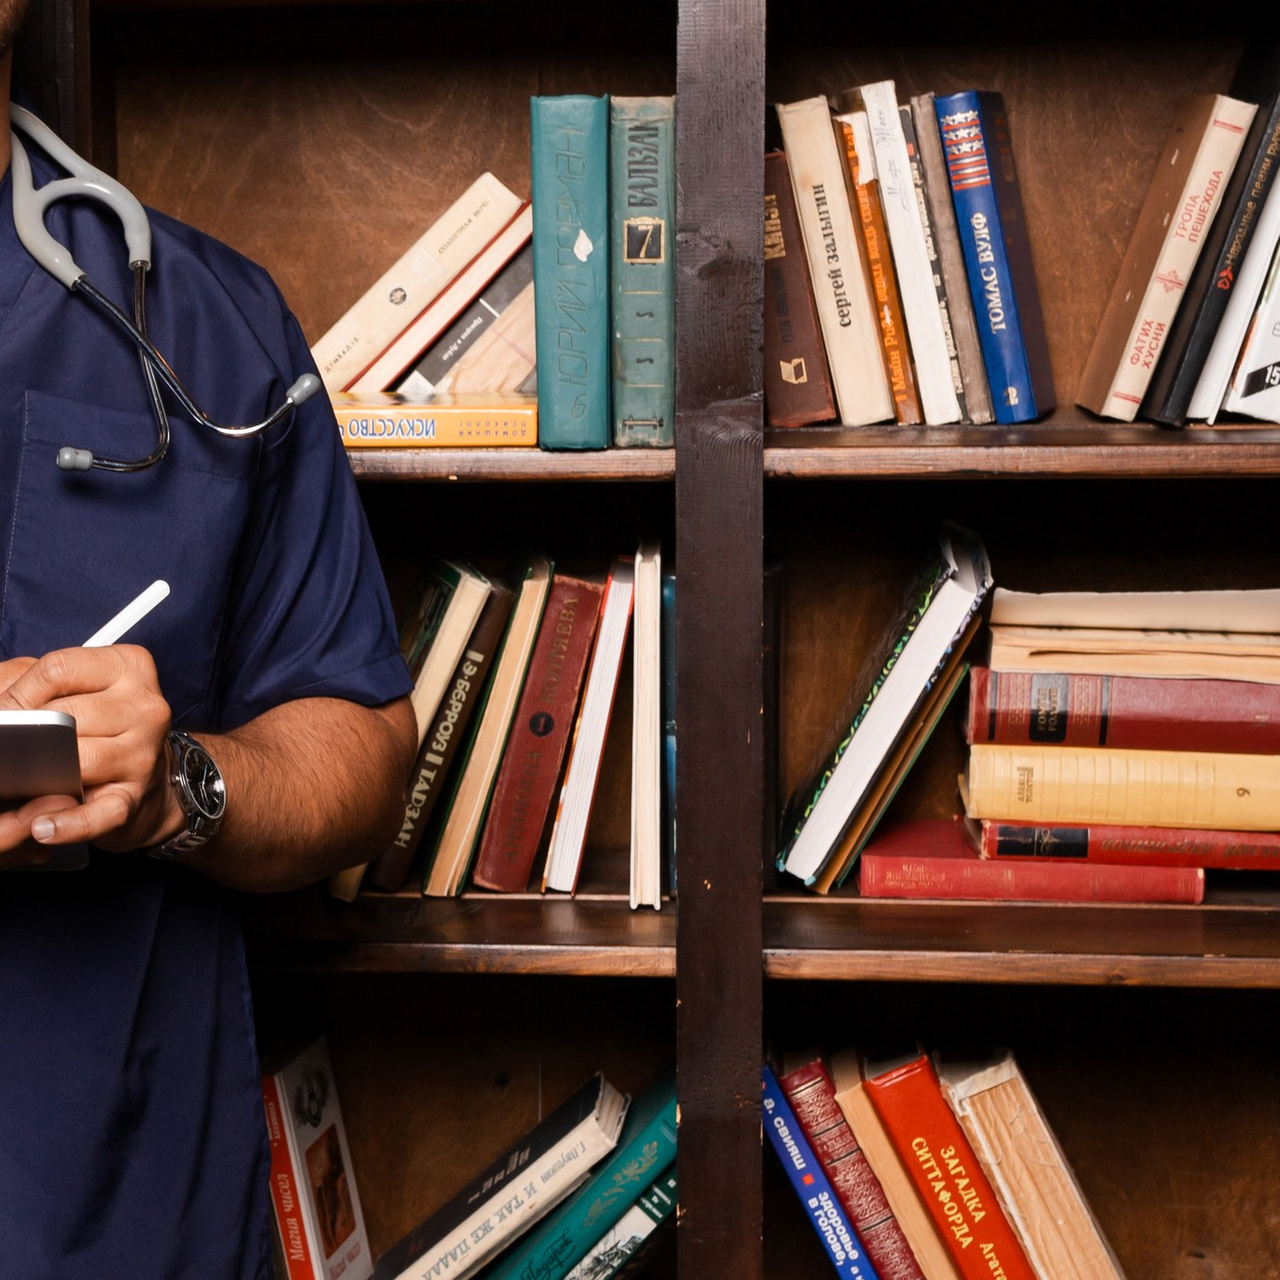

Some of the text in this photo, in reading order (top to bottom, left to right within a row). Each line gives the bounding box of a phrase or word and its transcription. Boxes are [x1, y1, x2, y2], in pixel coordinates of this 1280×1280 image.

[1175, 194, 1200, 239] ТРОПА
[1189, 170, 1223, 243] ПЕШЕХОДА
[554, 126, 588, 387] ЮРИЙ ГЕРМАН
[638, 226, 655, 258] 7
[812, 183, 853, 328] сергей залыгин
[971, 213, 1006, 335] ТОМАС ВУЛФ
[1130, 319, 1154, 366] ФАТИХ
[1142, 322, 1166, 369] ХУСНИ
[890, 347, 905, 396] Майн
[348, 418, 435, 438] ИСКУССТВО
[459, 420, 528, 428] ПСИХОЛОГ
[459, 428, 528, 438] ДОМАШНИЙ
[773, 1116, 807, 1171] свияш
[522, 1183, 538, 1198] И
[910, 1135, 971, 1250] СИТТАФОРДА
[939, 1144, 986, 1224] ЗАГАДКА
[276, 1174, 305, 1263] Магия чисел
[496, 1193, 525, 1224] ТАК
[817, 1191, 859, 1261] здоровье
[469, 1221, 495, 1246] ЖЕ
